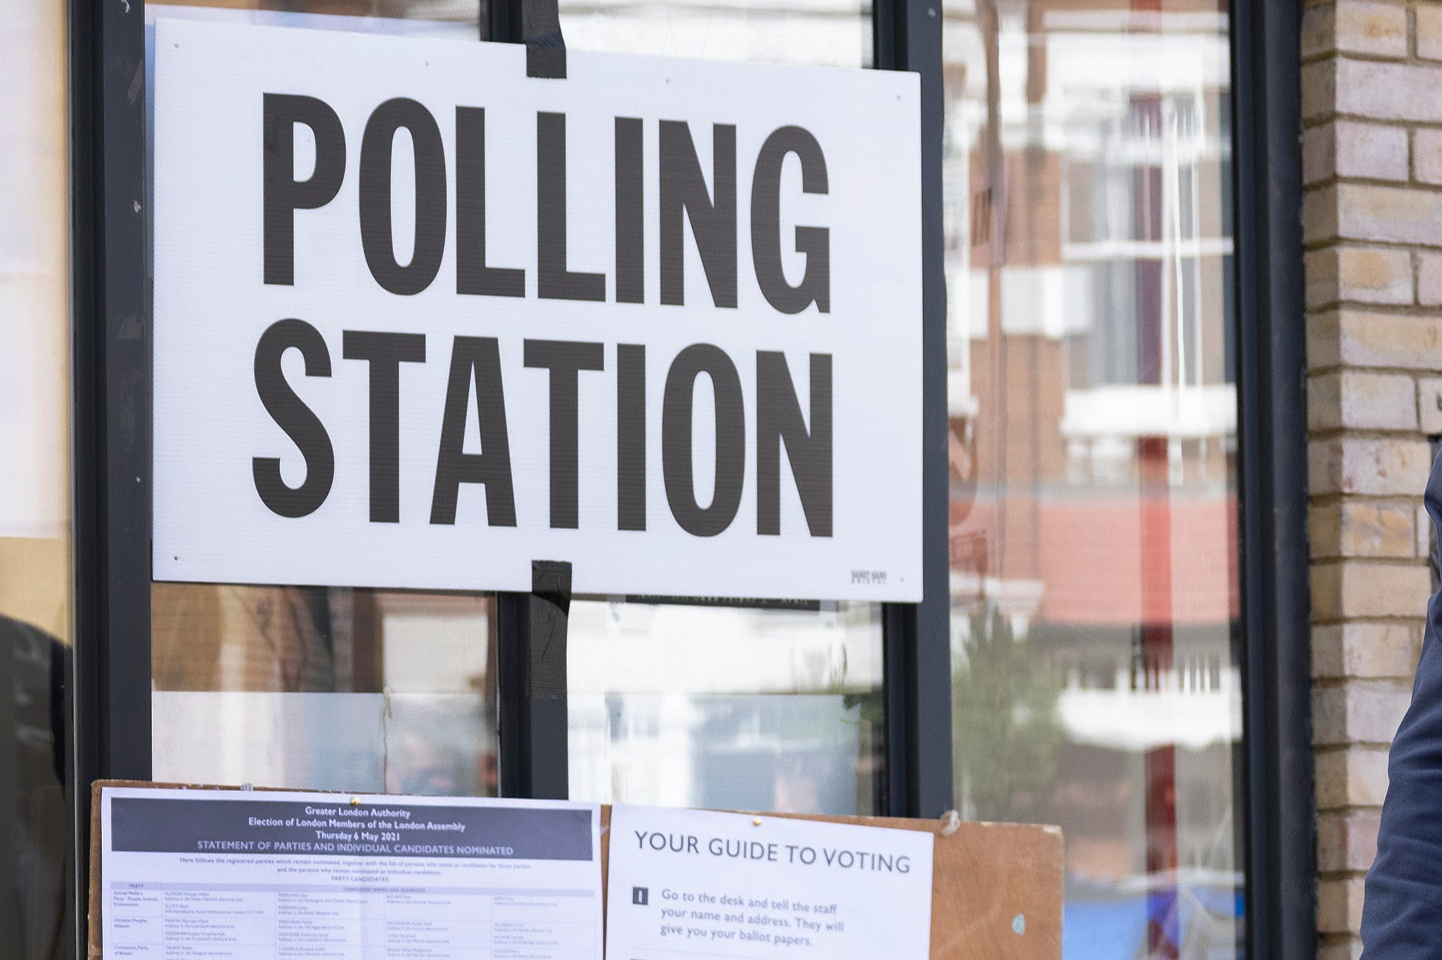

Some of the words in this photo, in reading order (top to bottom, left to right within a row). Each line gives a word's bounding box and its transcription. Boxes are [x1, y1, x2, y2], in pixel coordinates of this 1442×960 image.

[262, 92, 831, 315] POLLING
[252, 318, 833, 538] STATION
[304, 806, 336, 815] Greater
[338, 807, 369, 816] London
[370, 807, 411, 819] Authority
[248, 816, 283, 826] Election
[284, 817, 294, 826] of
[295, 817, 327, 827] London
[328, 818, 365, 828] Members
[367, 819, 377, 828] of
[378, 819, 392, 828] the
[393, 820, 425, 829] London
[426, 820, 465, 832] Assembly
[315, 828, 352, 842] Thursday
[353, 829, 359, 839] 6
[360, 830, 379, 843] May
[380, 830, 400, 840] 2021
[197, 840, 254, 849] STATEMENT
[257, 841, 271, 849] OF
[273, 841, 312, 850] PARTIES
[313, 842, 335, 851] AND
[336, 843, 391, 852] INDIVIDUAL
[393, 844, 454, 853] CANDIDATES
[455, 845, 513, 855] NOMINATED
[634, 831, 699, 853] YOUR
[708, 838, 777, 860] GUIDE
[785, 845, 816, 864] TO
[823, 848, 909, 873] VOTING
[660, 888, 678, 899] Go
[682, 890, 694, 901] to
[698, 891, 716, 903] the
[719, 893, 744, 906] desk
[747, 897, 768, 908] and
[771, 898, 788, 910] tell
[791, 900, 810, 912] the
[813, 903, 837, 914] staff
[660, 908, 686, 918] your
[690, 911, 721, 920] name
[723, 911, 744, 922] and
[795, 916, 821, 932] They
[825, 919, 844, 931] will
[660, 923, 682, 935] give
[687, 927, 707, 938] you
[710, 929, 735, 940] your
[739, 929, 770, 942] ballot
